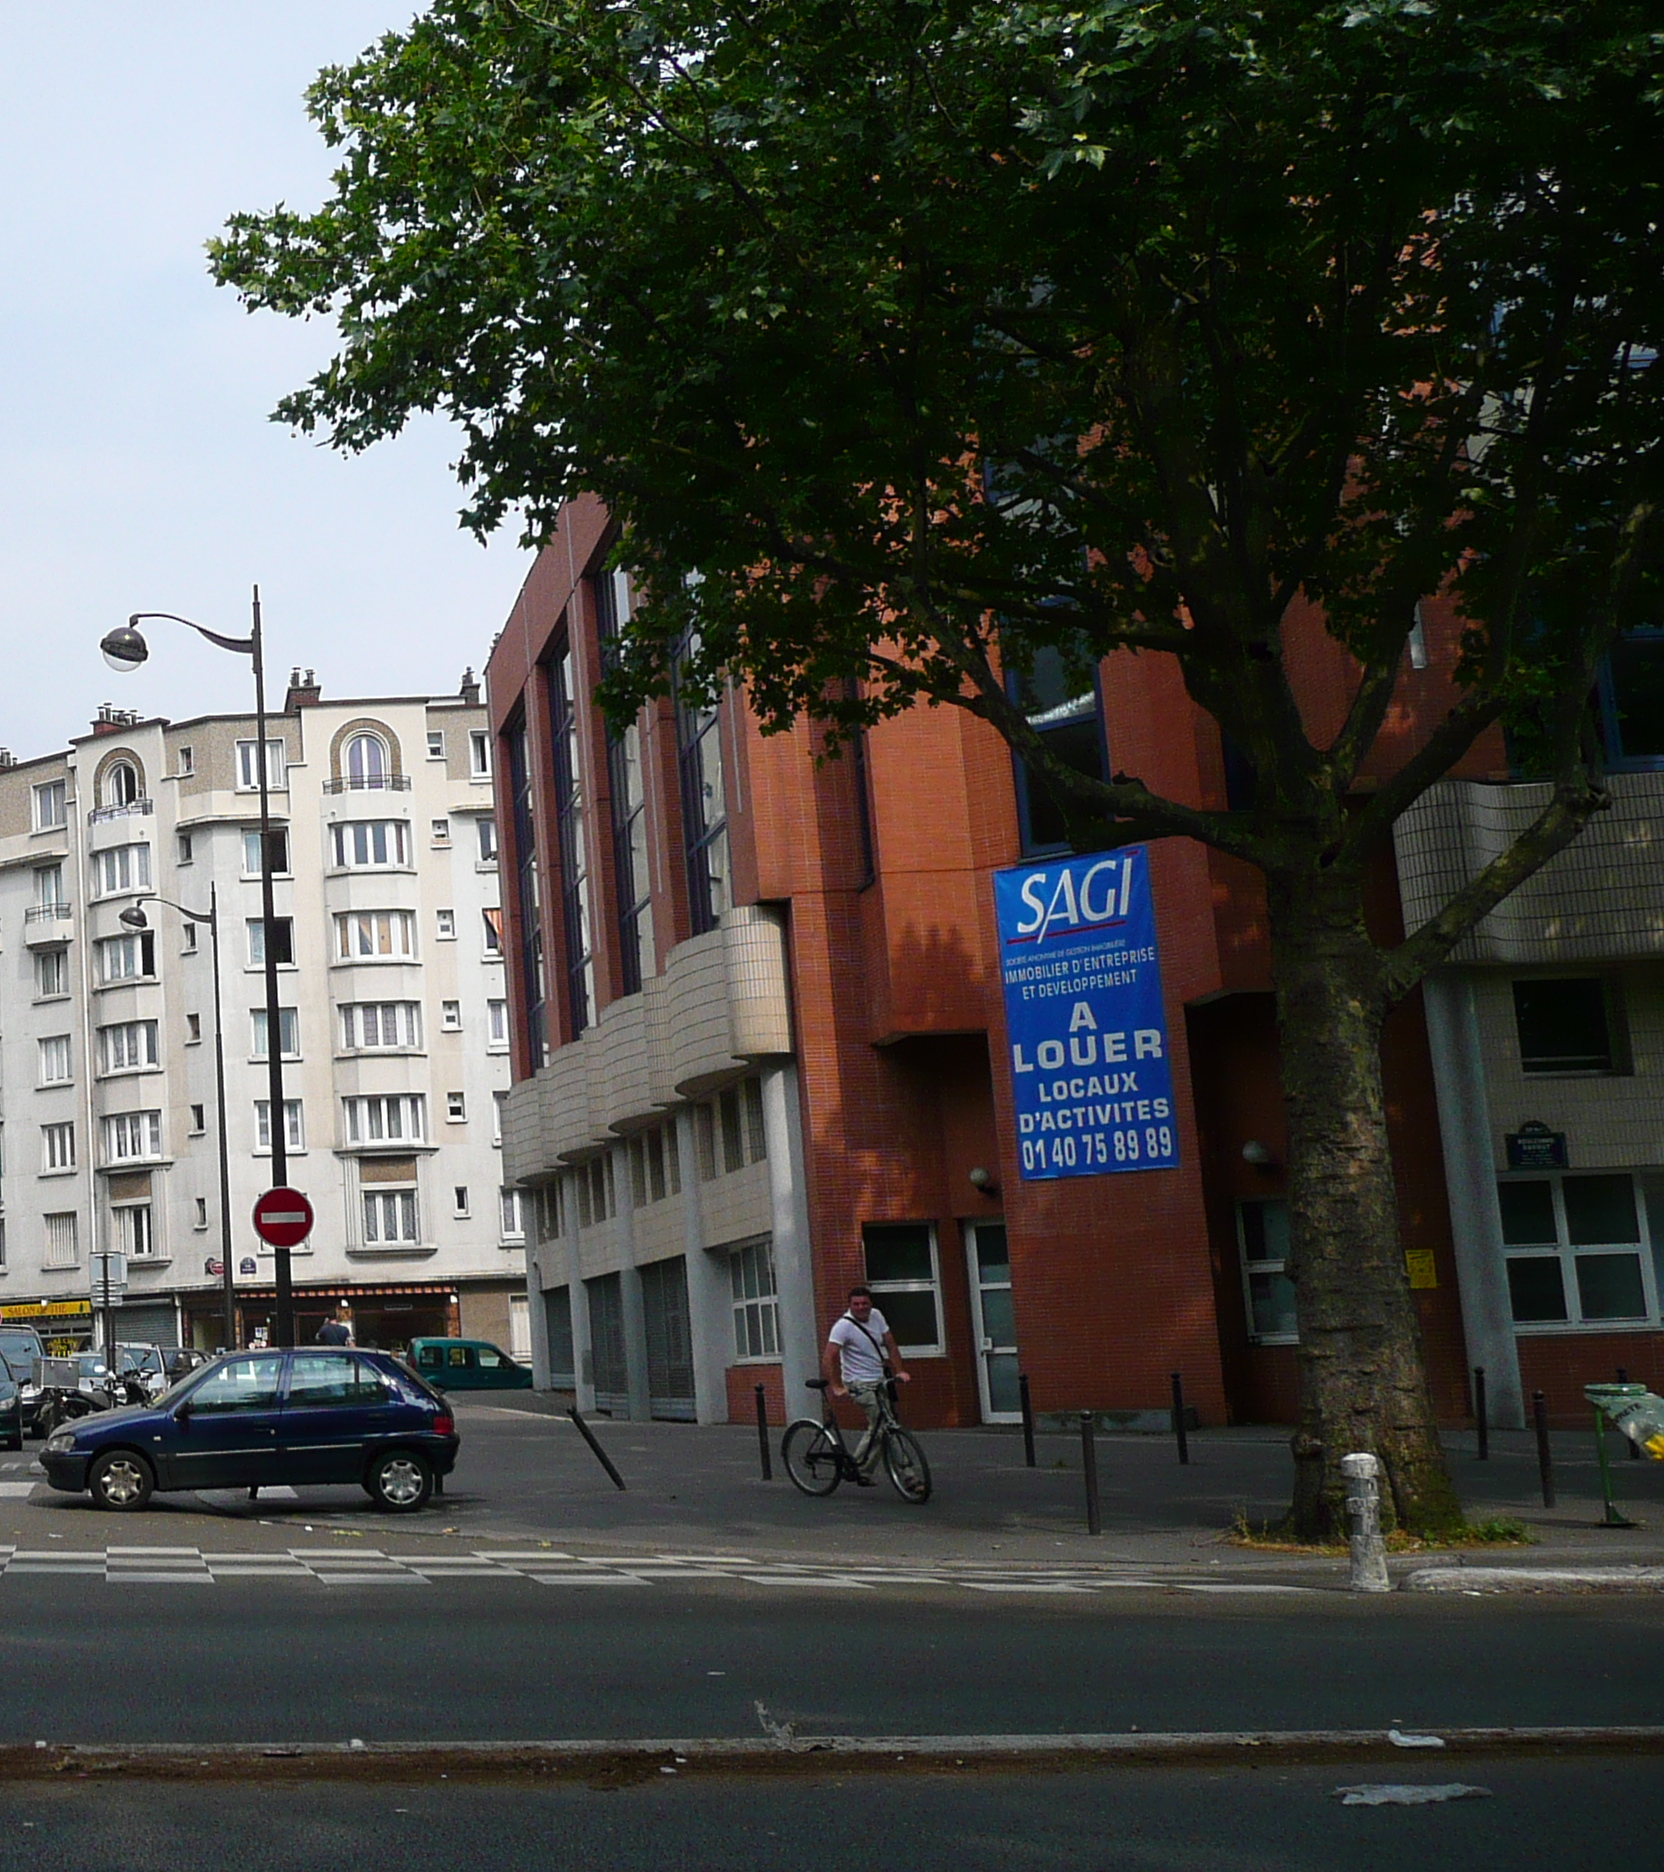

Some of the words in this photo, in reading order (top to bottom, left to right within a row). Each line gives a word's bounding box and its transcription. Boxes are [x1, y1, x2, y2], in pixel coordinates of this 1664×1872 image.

[1017, 858, 1132, 944] SAGI
[1005, 961, 1069, 984] IMMOBILIER
[1073, 947, 1155, 973] D'ENTREPRISE
[1022, 986, 1035, 1000] ET
[1039, 969, 1137, 998] DEVELOPPEMENT
[1069, 1001, 1097, 1032] A
[1013, 1029, 1162, 1073] LOUER
[1039, 1071, 1139, 1102] LOCAUX
[1019, 1098, 1170, 1133] D'ACTIVITES
[1022, 1139, 1046, 1170] 01
[1052, 1136, 1076, 1167] 40
[1082, 1133, 1107, 1165] 75
[1114, 1129, 1139, 1161] 89
[1146, 1126, 1171, 1158] 89
[8, 1306, 35, 1317] SALON
